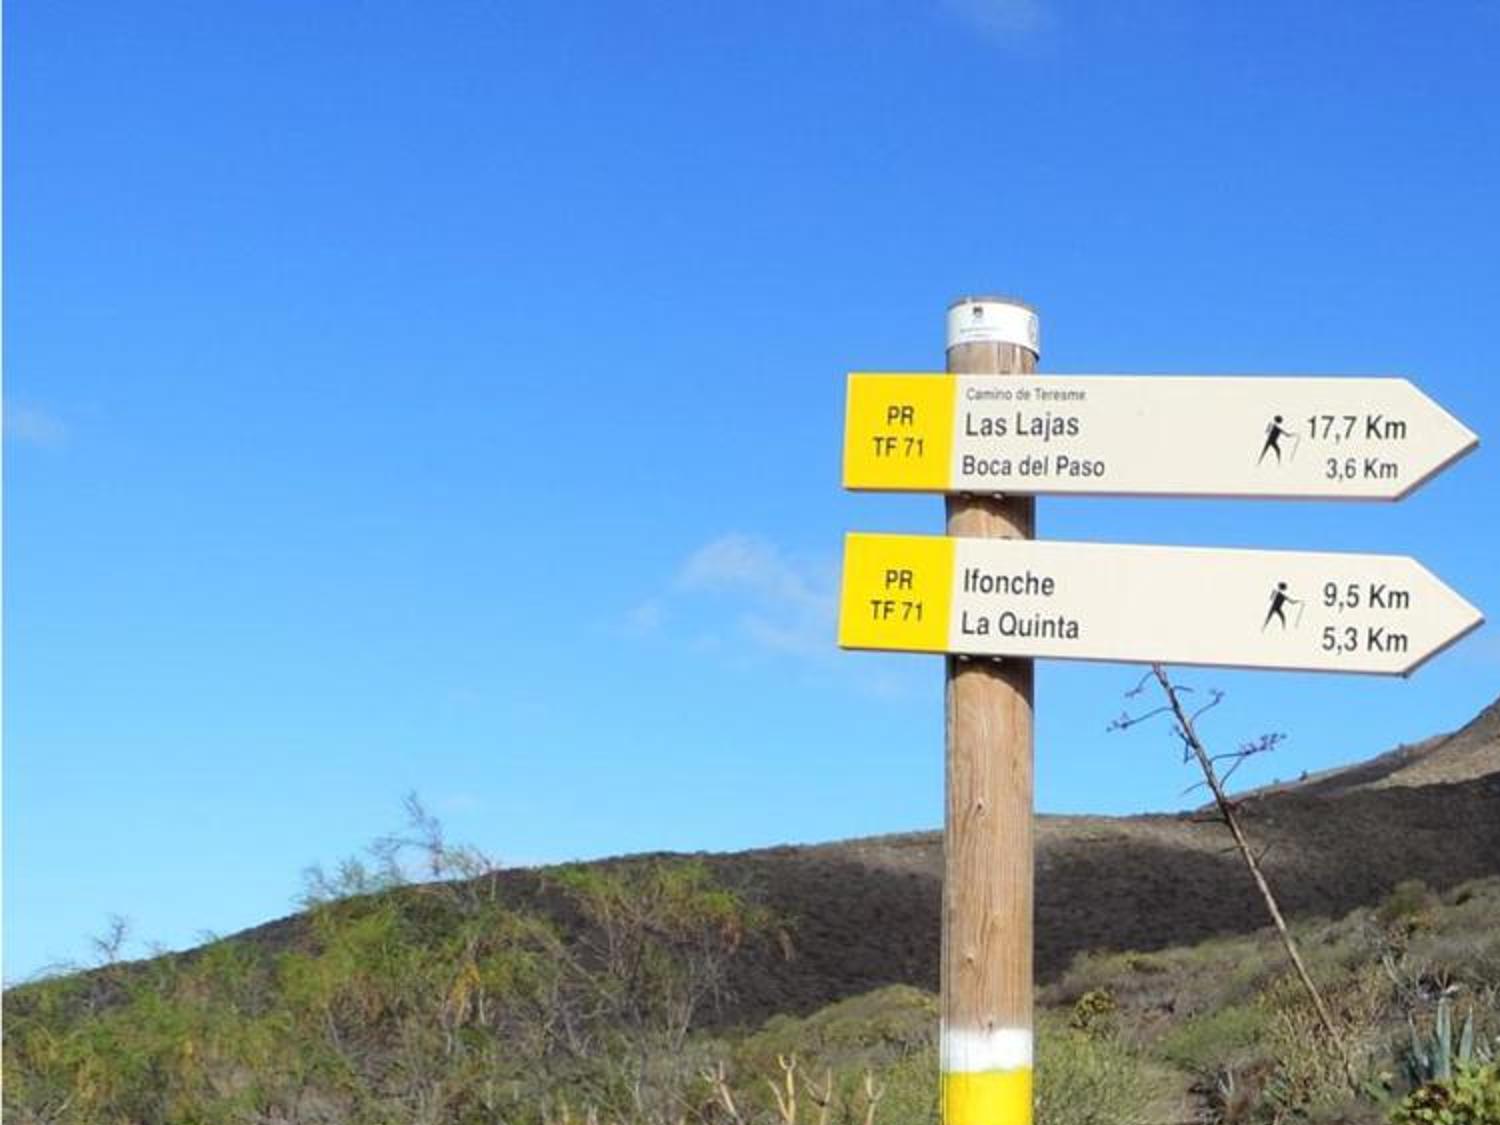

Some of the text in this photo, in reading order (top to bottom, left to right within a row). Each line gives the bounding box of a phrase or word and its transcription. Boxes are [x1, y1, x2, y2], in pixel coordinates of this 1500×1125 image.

[966, 388, 1012, 401] Camino
[1016, 388, 1031, 401] de
[887, 406, 915, 425] PR
[965, 412, 1079, 442] Las Lajas
[1307, 415, 1407, 444] 17,7 Km
[873, 437, 924, 457] TF 71
[962, 455, 1105, 477] Boca del Paso
[1326, 458, 1398, 482] 3,6 Km
[885, 569, 913, 590] PR
[963, 567, 1055, 596] Ifonche
[1323, 582, 1410, 613] 9,5 Km
[870, 600, 923, 621] TF 71
[961, 611, 1079, 639] La Quinta
[1322, 626, 1408, 655] 5,3 Km
